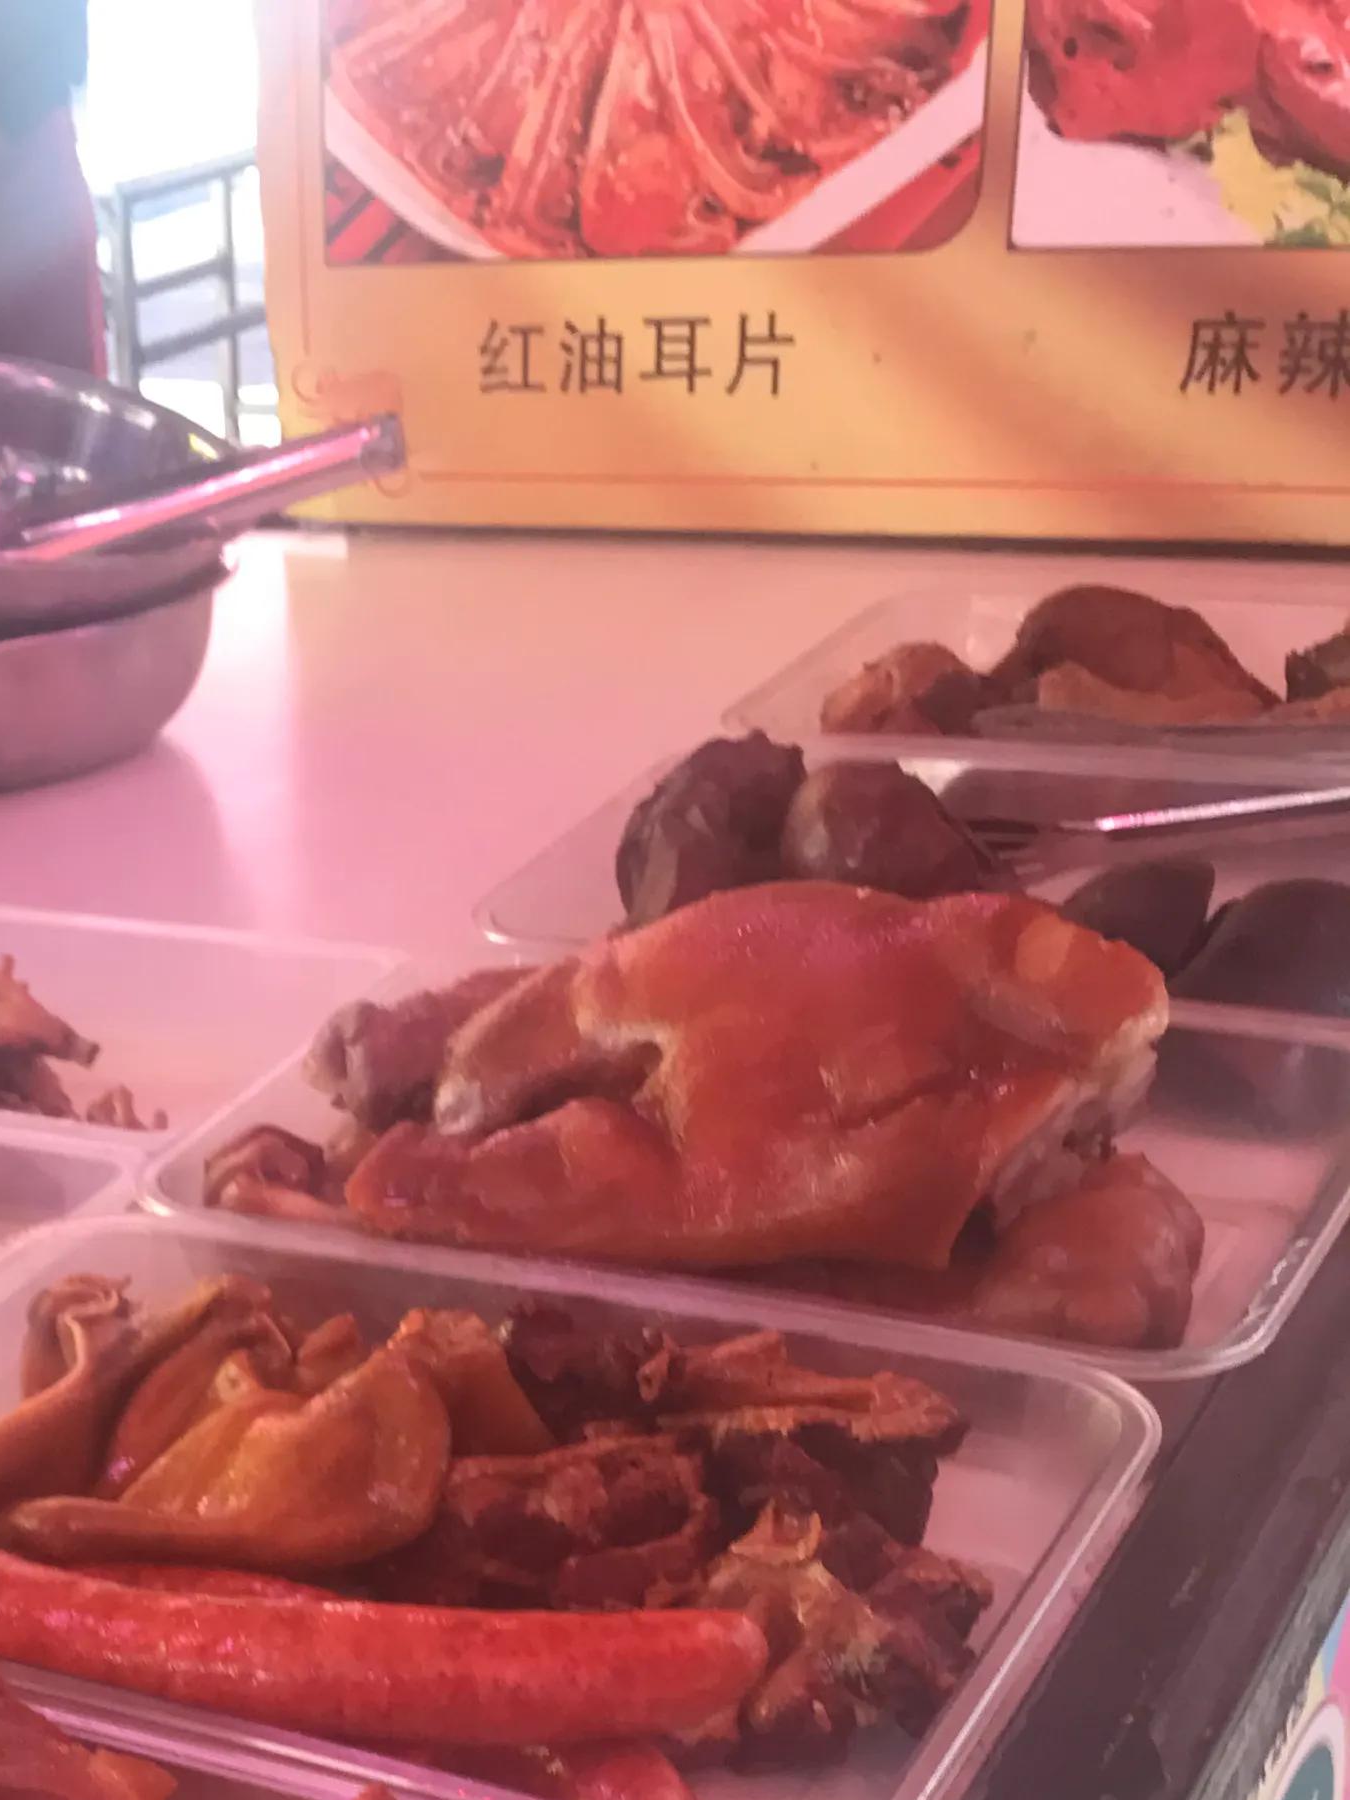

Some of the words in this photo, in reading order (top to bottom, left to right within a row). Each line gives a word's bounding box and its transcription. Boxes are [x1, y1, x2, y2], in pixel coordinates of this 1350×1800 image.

[479, 311, 795, 396] 红油耳片
[1178, 310, 1350, 400] 麻辣
